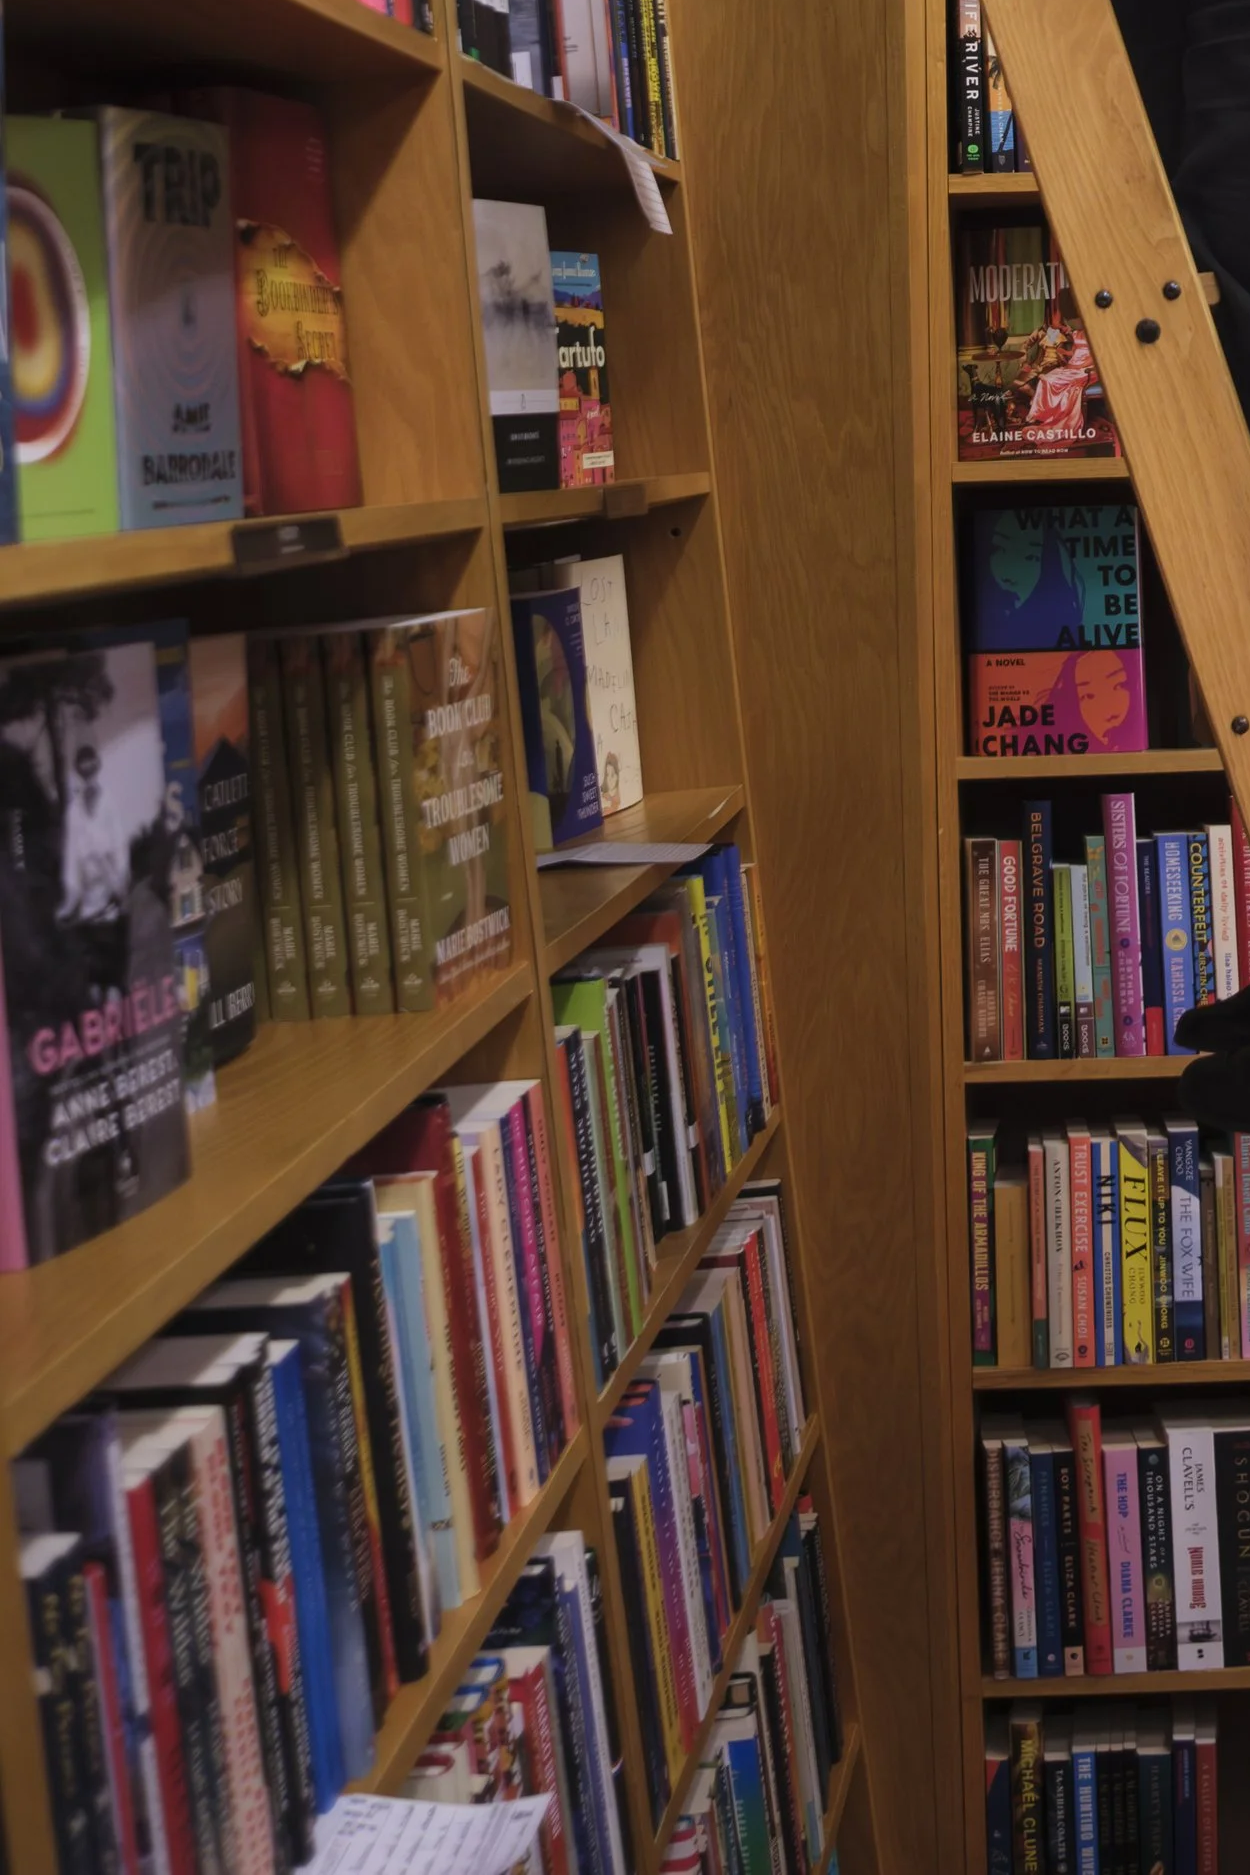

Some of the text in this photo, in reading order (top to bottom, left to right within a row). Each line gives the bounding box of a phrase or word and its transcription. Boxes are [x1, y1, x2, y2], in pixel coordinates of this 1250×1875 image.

[965, 42, 980, 100] RIVER
[133, 142, 222, 229] TRIP
[554, 325, 606, 368] artufo
[972, 427, 1097, 443] ELAINE CASTILLO
[1015, 506, 1105, 531] WHAT
[1065, 535, 1137, 559] TIME
[1097, 564, 1137, 587] TO
[1104, 593, 1139, 617] BE
[1056, 623, 1140, 649] ALIVE
[448, 658, 472, 686] The
[426, 694, 492, 739] BOOK CLUB
[982, 704, 1056, 728] JADE
[982, 732, 1090, 757] CHANG
[421, 772, 504, 829] TROUBLESOME
[1110, 800, 1126, 849] SISTERS
[448, 823, 490, 866] WOMEN
[398, 856, 409, 893] WOMEN
[1030, 811, 1045, 949] BELGRAVE ROAD
[1164, 841, 1183, 921] HOMESEEKING
[1190, 842, 1208, 943] COUNTERFEIT
[1003, 855, 1018, 953] GOOD FORTUNE
[410, 918, 422, 952] MARIE
[436, 905, 511, 966] MARIE BOSTWICK
[28, 975, 181, 1076] GABRIËLE
[44, 1078, 181, 1167] CLAIRE BEREST
[51, 1078, 113, 1129] ANNE
[971, 1151, 990, 1291] KING THE ARMADILLOS
[1073, 1143, 1089, 1252] TRUST EXERCISE
[1096, 1175, 1117, 1226] NIKI
[1122, 1175, 1149, 1262] FLUX
[1180, 1196, 1195, 1299] THE FOX WIFE
[1121, 1598, 1135, 1639] CLARKE
[1077, 1757, 1095, 1841] THE HUNTING
